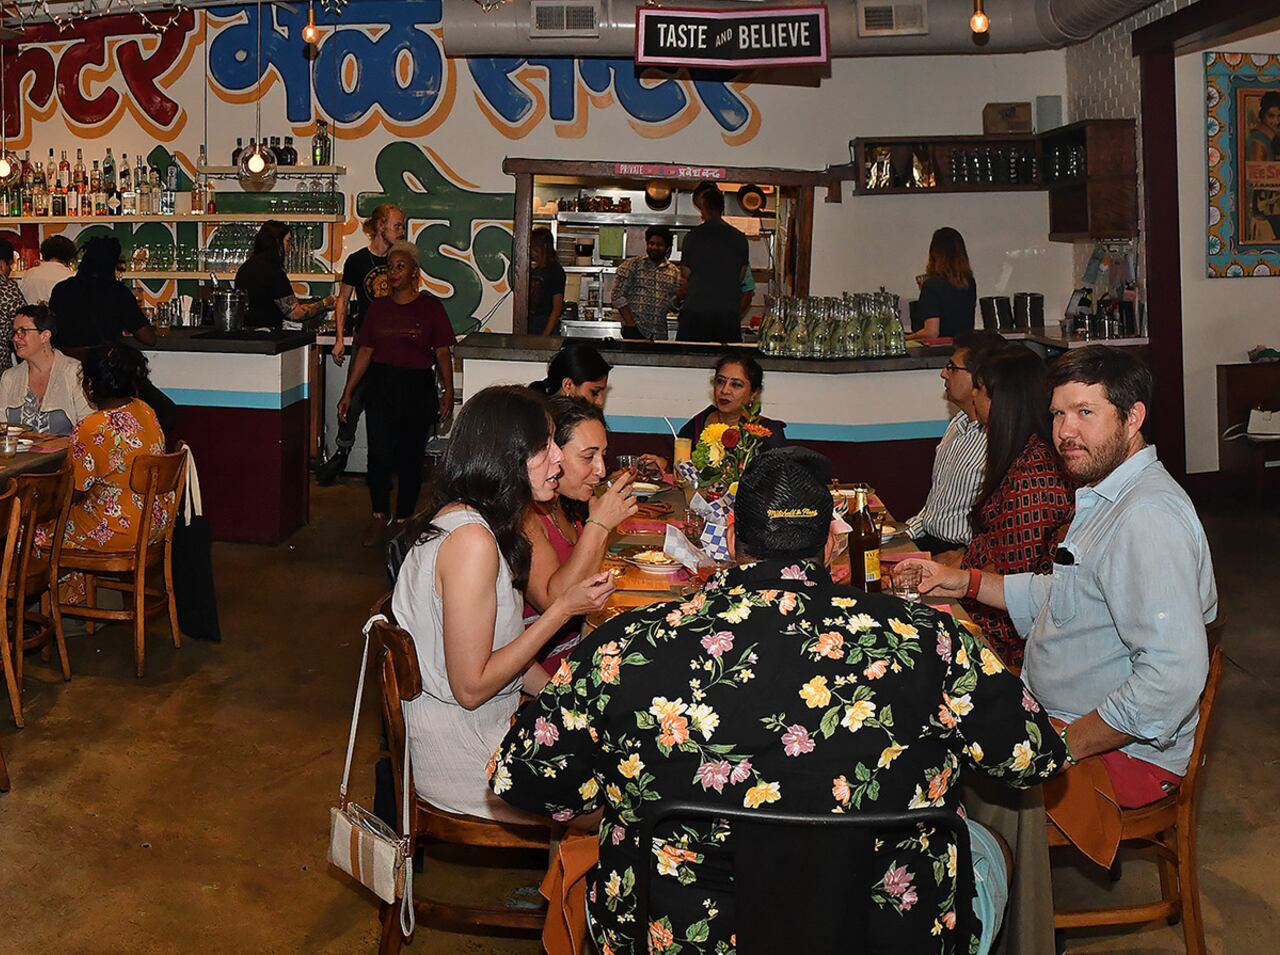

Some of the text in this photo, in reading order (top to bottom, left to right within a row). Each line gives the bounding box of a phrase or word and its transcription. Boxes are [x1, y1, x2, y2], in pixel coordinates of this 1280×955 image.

[657, 22, 810, 49] TASTE AND BELIEVE
[620, 163, 643, 175] PRIVATE
